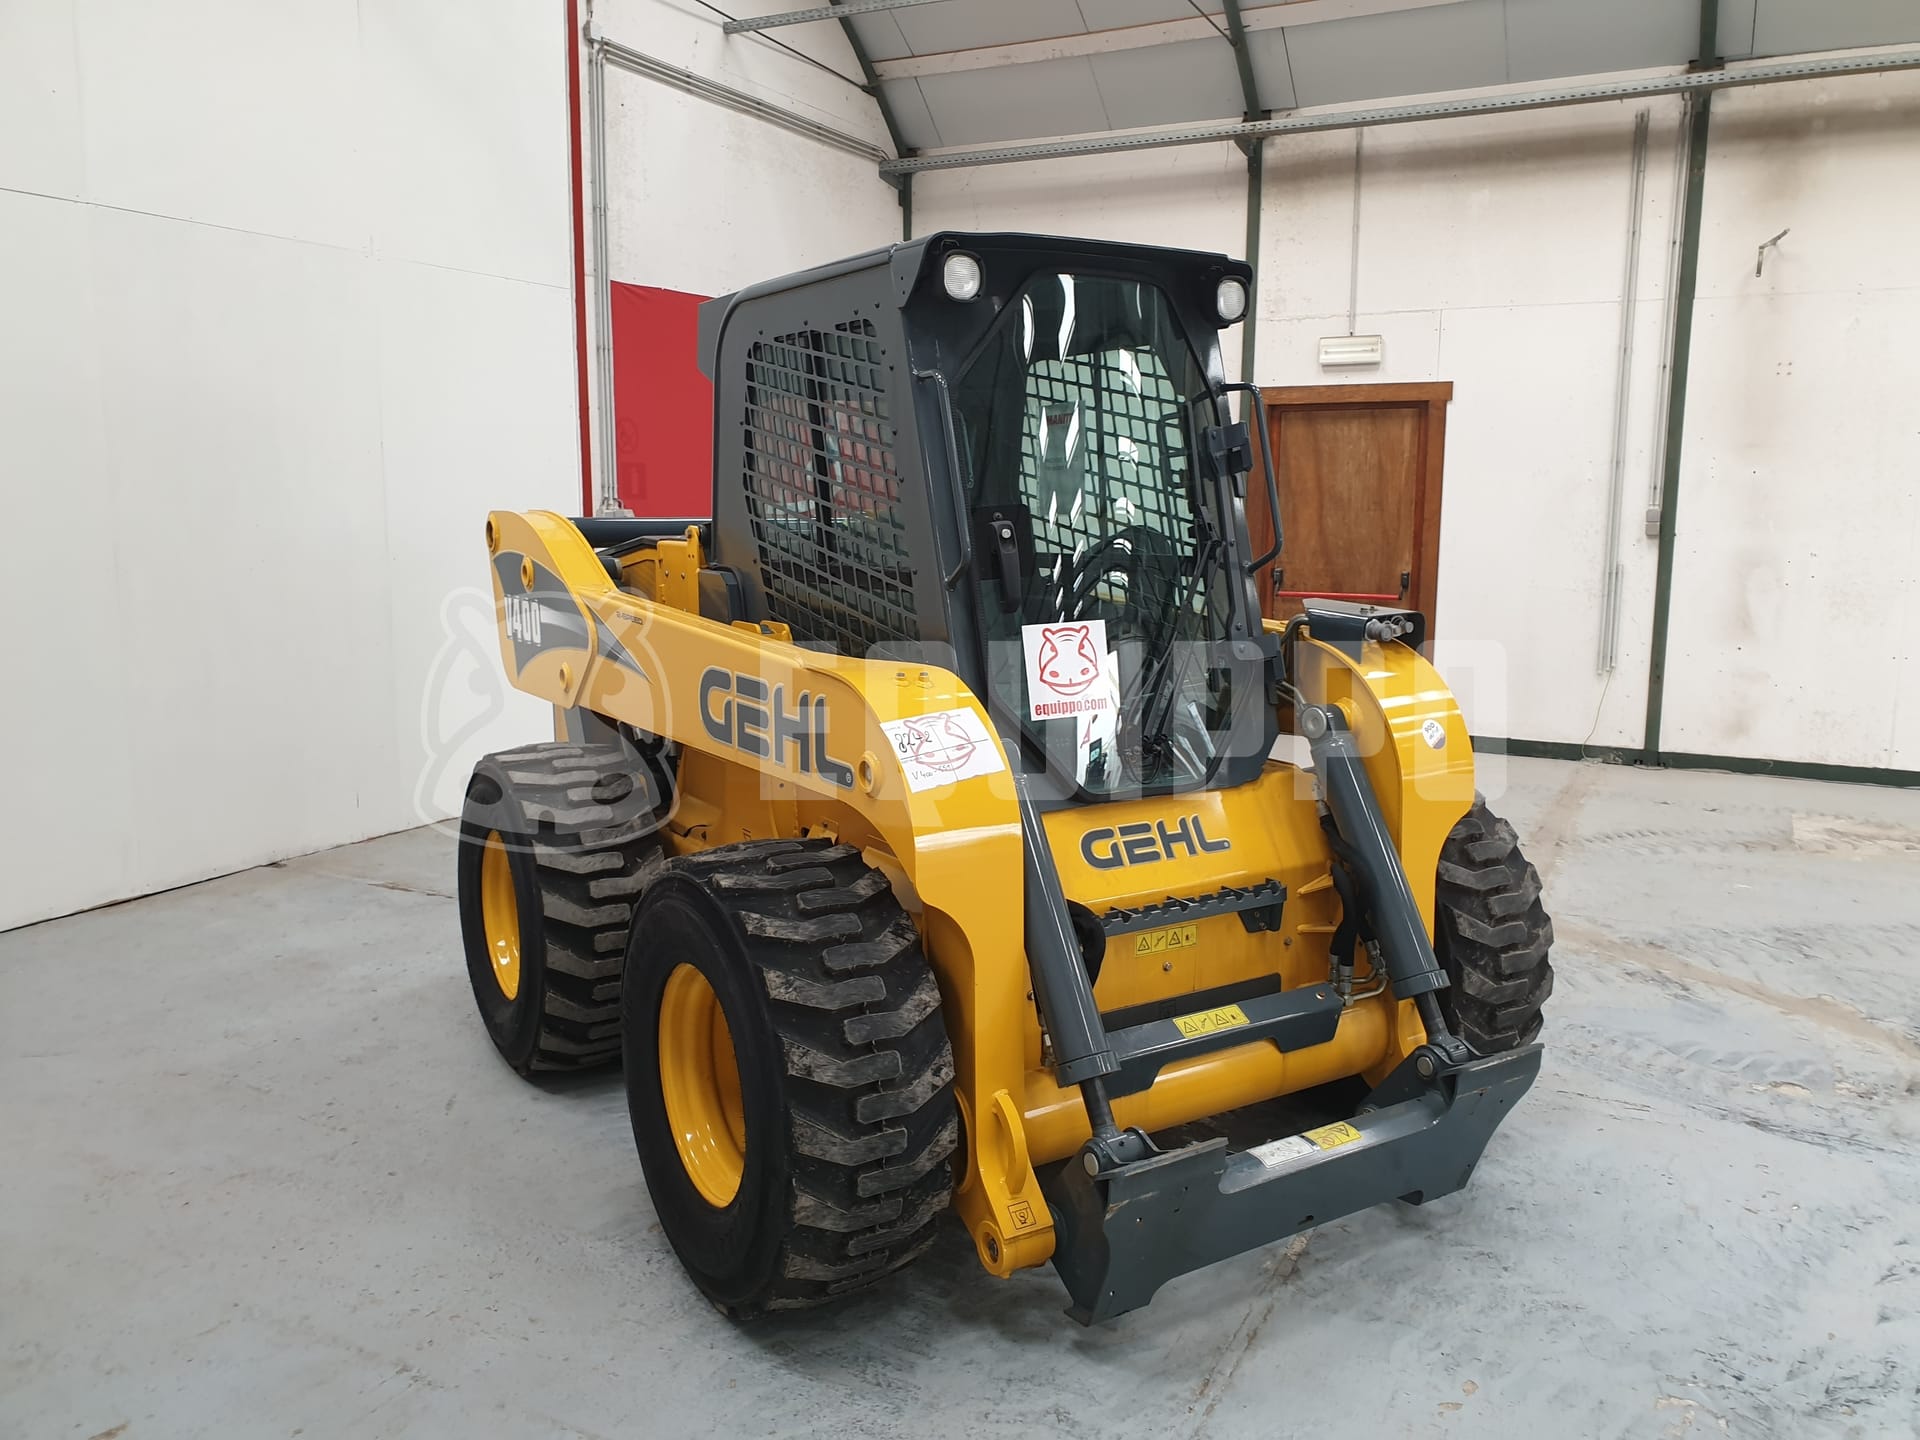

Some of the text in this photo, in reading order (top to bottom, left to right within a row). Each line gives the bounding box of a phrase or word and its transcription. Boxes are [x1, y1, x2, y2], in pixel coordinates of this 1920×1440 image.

[699, 664, 854, 789] GEHL
[1034, 697, 1108, 717] equippo.com
[1080, 813, 1231, 871] GEHL
